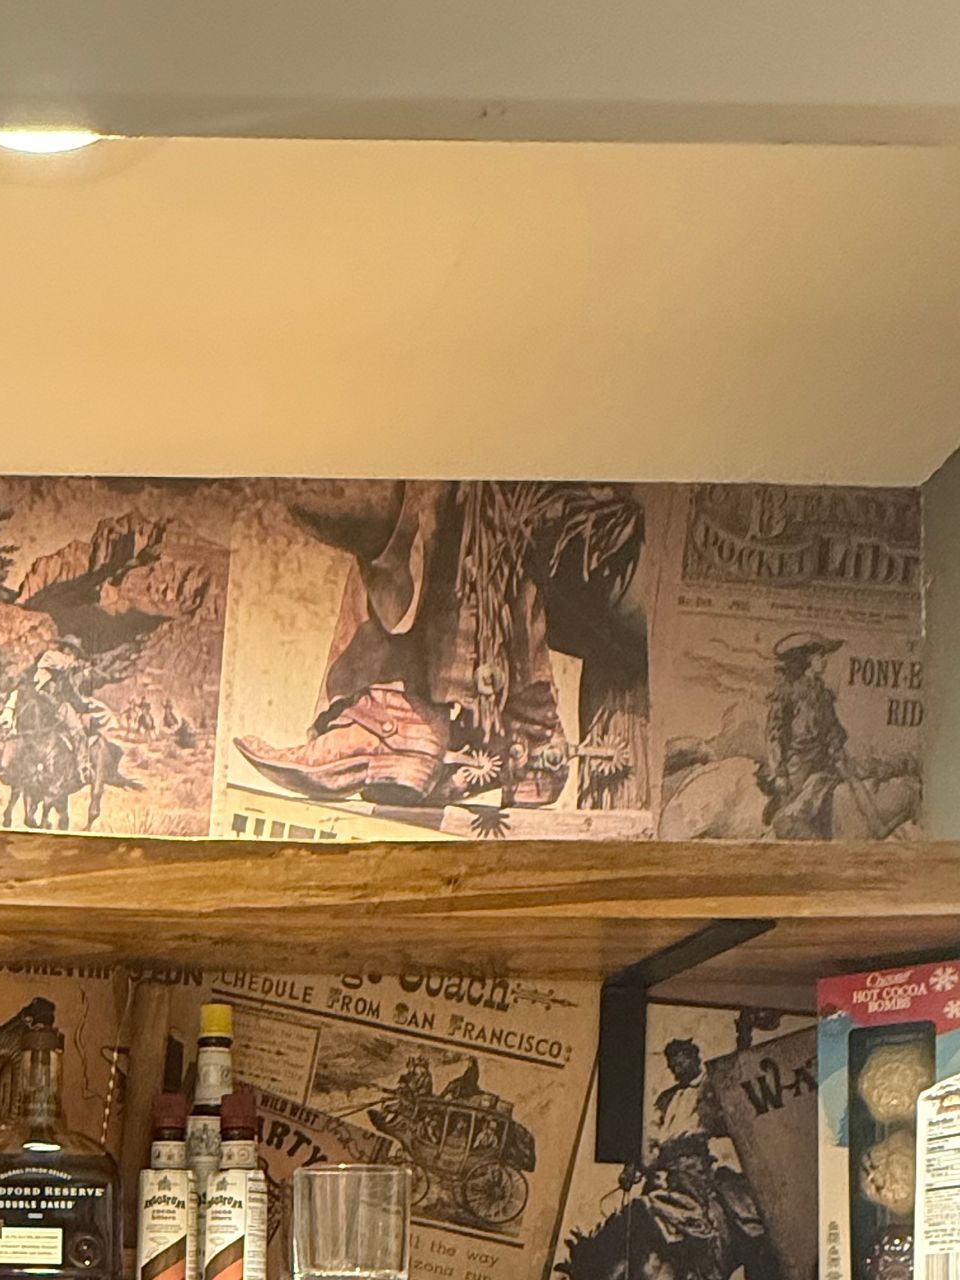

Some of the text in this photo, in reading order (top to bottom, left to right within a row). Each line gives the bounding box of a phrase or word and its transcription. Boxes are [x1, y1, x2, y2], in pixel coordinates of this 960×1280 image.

[852, 982, 928, 1004] HOT COCOA
[867, 996, 912, 1014] BOMBS
[326, 986, 382, 1020] FROM
[395, 1002, 436, 1031] SAN
[260, 1092, 320, 1127] WILD WEST
[44, 1185, 105, 1198] RESERVE
[430, 1240, 457, 1257] the
[467, 1248, 500, 1268] way
